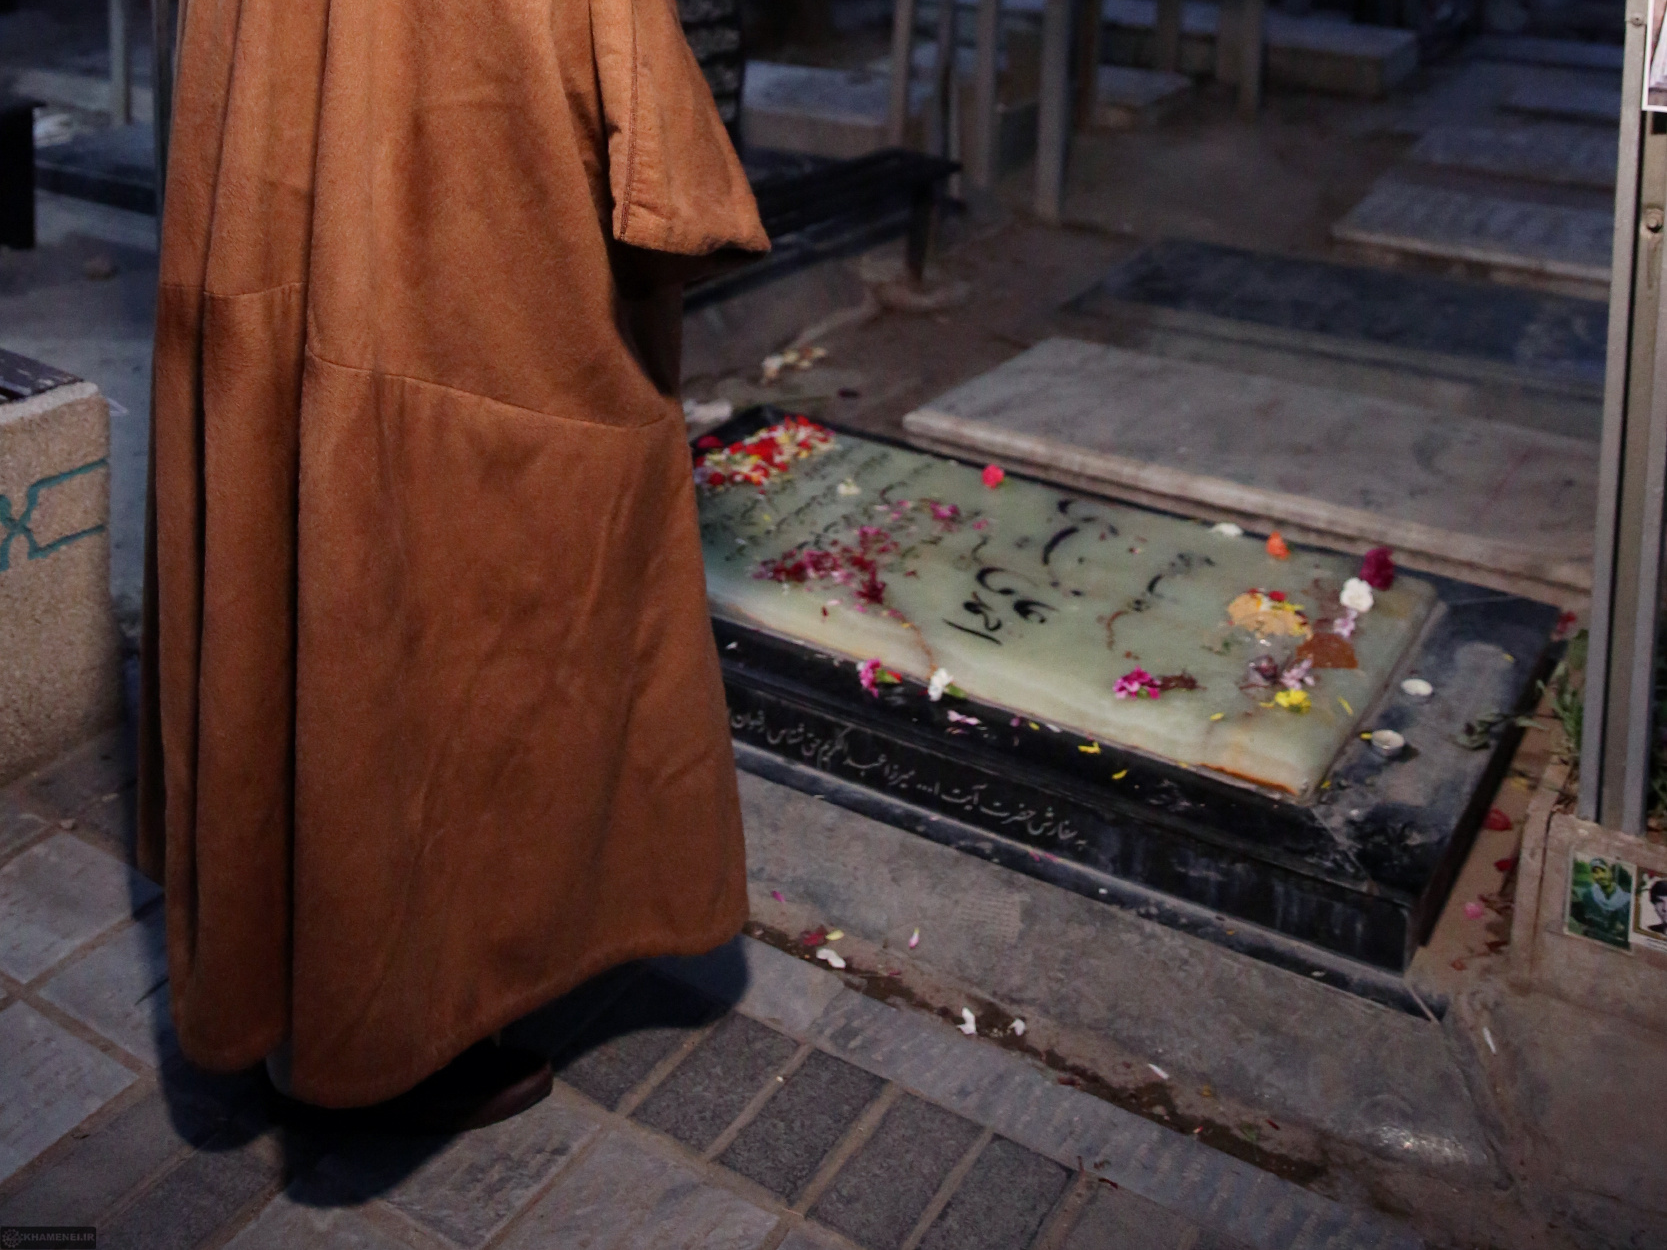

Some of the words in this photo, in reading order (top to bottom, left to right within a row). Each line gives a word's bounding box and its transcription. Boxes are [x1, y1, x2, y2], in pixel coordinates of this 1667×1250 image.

[940, 783, 988, 811] آیت
[979, 801, 1037, 825] حضرت
[1027, 806, 1078, 840] سفارش
